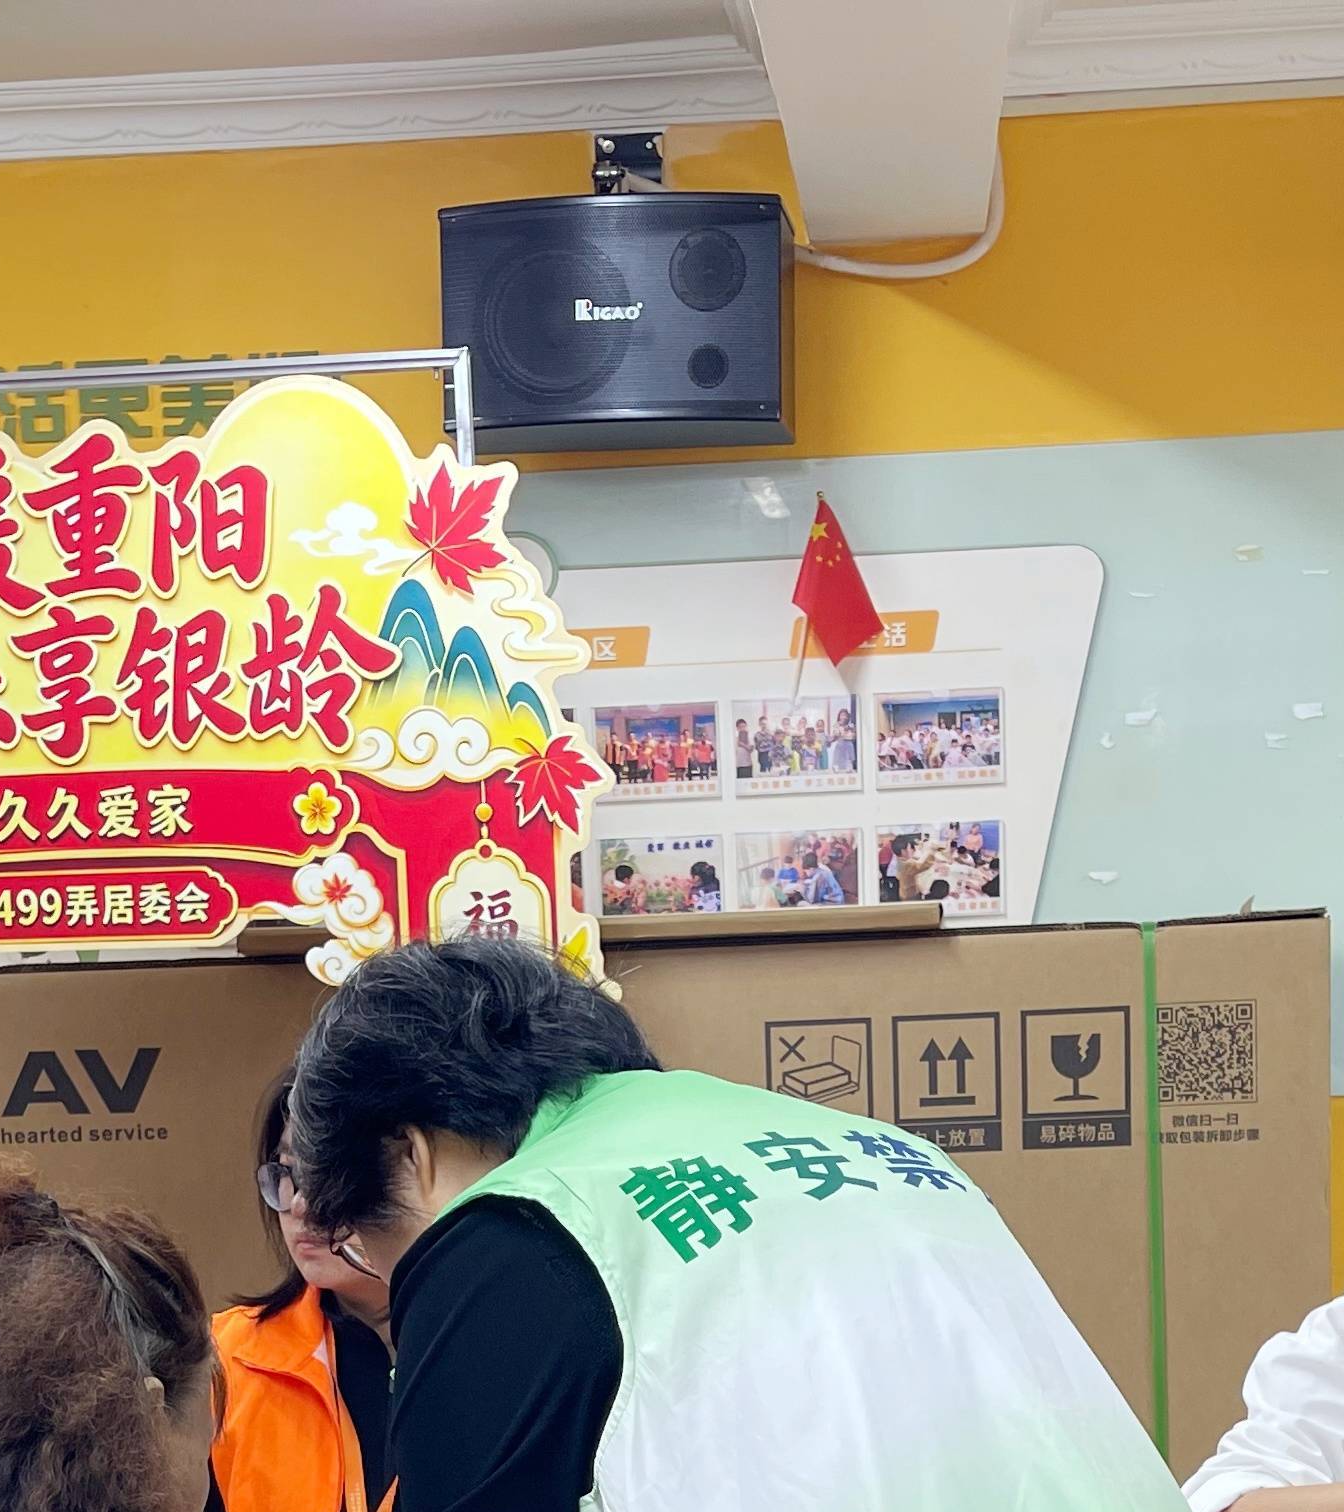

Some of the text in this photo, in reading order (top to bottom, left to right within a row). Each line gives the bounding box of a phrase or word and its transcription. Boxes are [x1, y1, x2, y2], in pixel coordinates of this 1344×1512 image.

[858, 623, 907, 649] 活
[594, 636, 616, 661] 区
[1172, 1112, 1239, 1127] 微信扫一扫
[89, 1123, 168, 1142] service
[1039, 1123, 1116, 1144] 易碎物品
[619, 1130, 968, 1263] 静安禁
